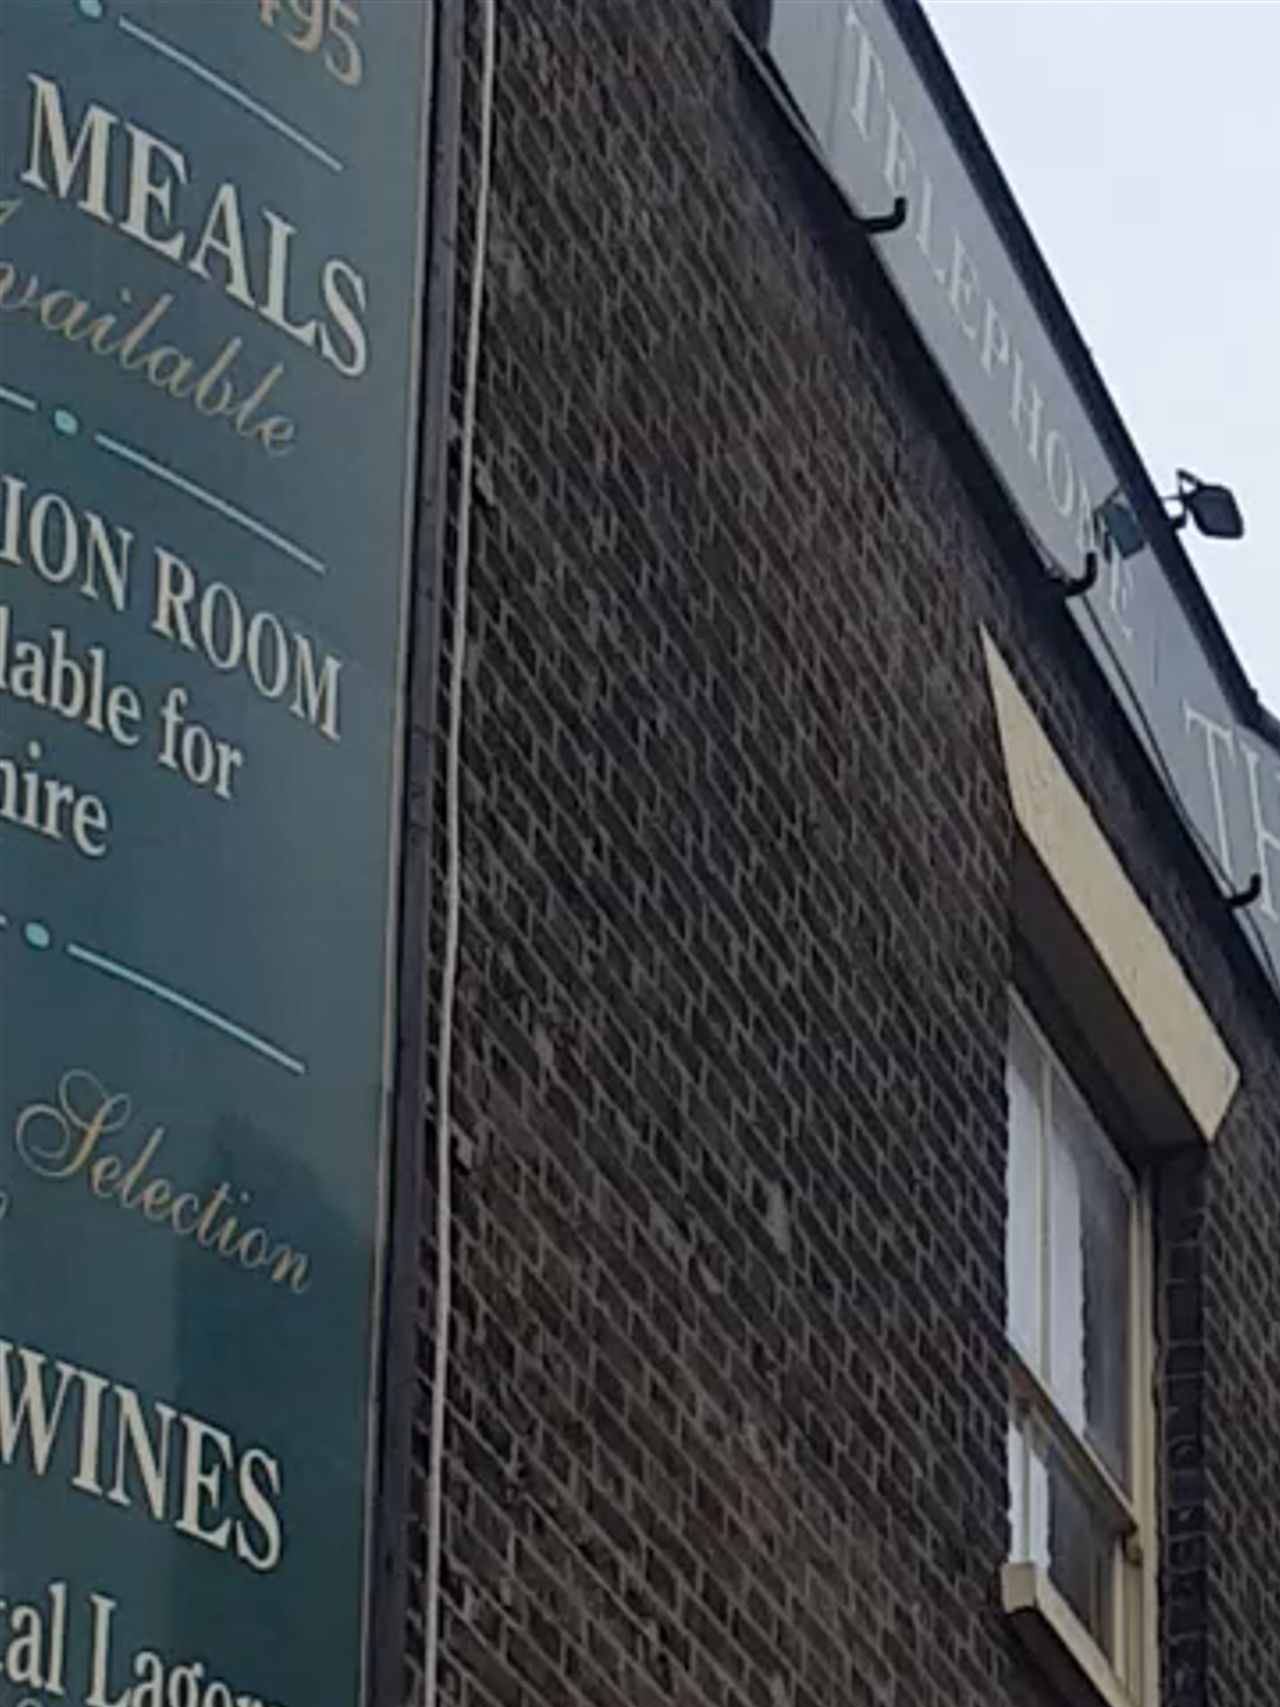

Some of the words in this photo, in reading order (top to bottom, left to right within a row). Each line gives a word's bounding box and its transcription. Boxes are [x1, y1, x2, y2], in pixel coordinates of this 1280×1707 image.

[0, 200, 296, 458] vailable
[20, 71, 369, 378] MEALS
[150, 544, 343, 743] ROOM
[158, 687, 243, 800] for
[14, 1068, 313, 1295] Selection
[0, 1338, 283, 1571] WINES
